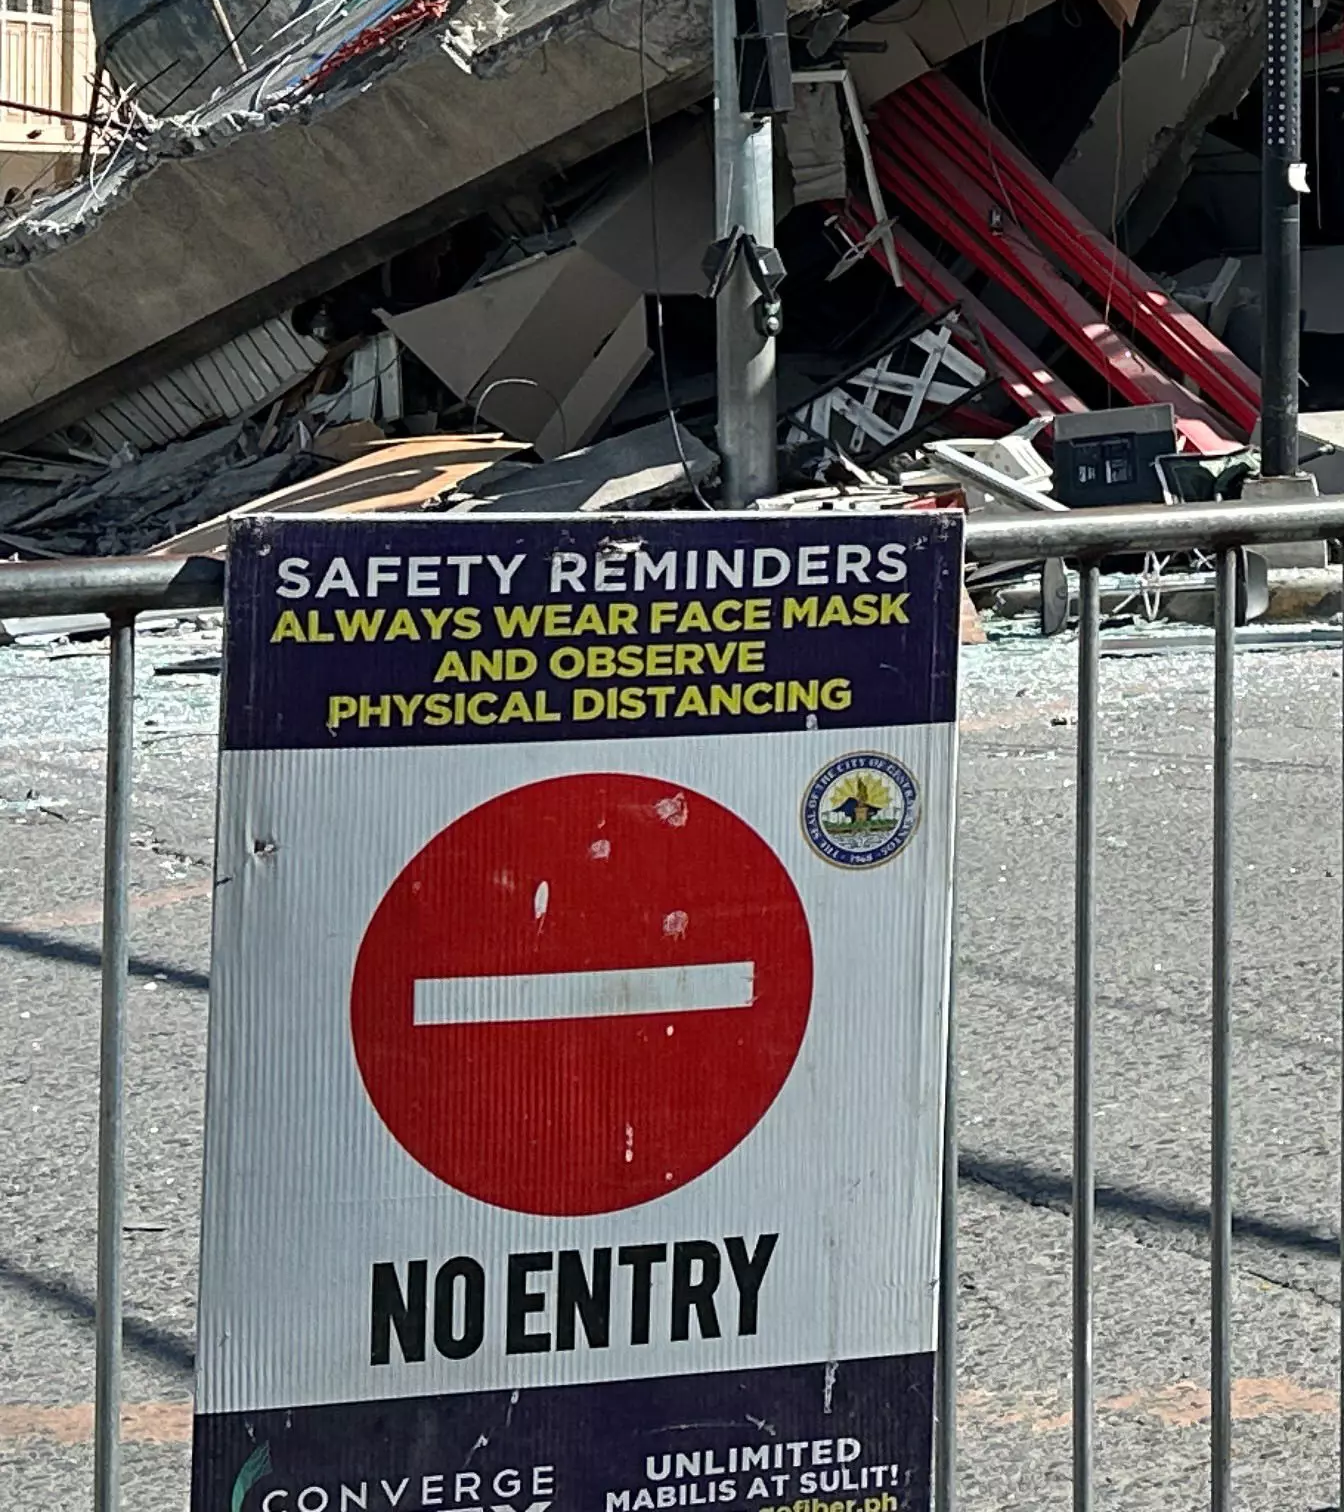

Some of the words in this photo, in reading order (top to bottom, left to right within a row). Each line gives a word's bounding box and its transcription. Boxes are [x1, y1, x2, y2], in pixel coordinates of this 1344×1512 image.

[275, 554, 527, 599] SAFETY
[551, 543, 908, 593] REMINDERS
[271, 608, 482, 644] ALWAYS
[495, 602, 637, 638] WEAR
[650, 598, 774, 634] FACE
[782, 593, 910, 629] MASK
[433, 651, 538, 684] AND
[549, 640, 766, 677] OBSERVE
[328, 690, 561, 731] PHYSICAL
[573, 679, 852, 722] DISTANCING
[370, 1257, 486, 1366] NO
[505, 1232, 780, 1356] ENTRY
[646, 1437, 861, 1481] UNLIMITED
[262, 1465, 555, 1512] CONVERGE
[605, 1480, 737, 1512] MABILIS
[746, 1474, 790, 1500] AT
[799, 1464, 899, 1494] SULIT!
